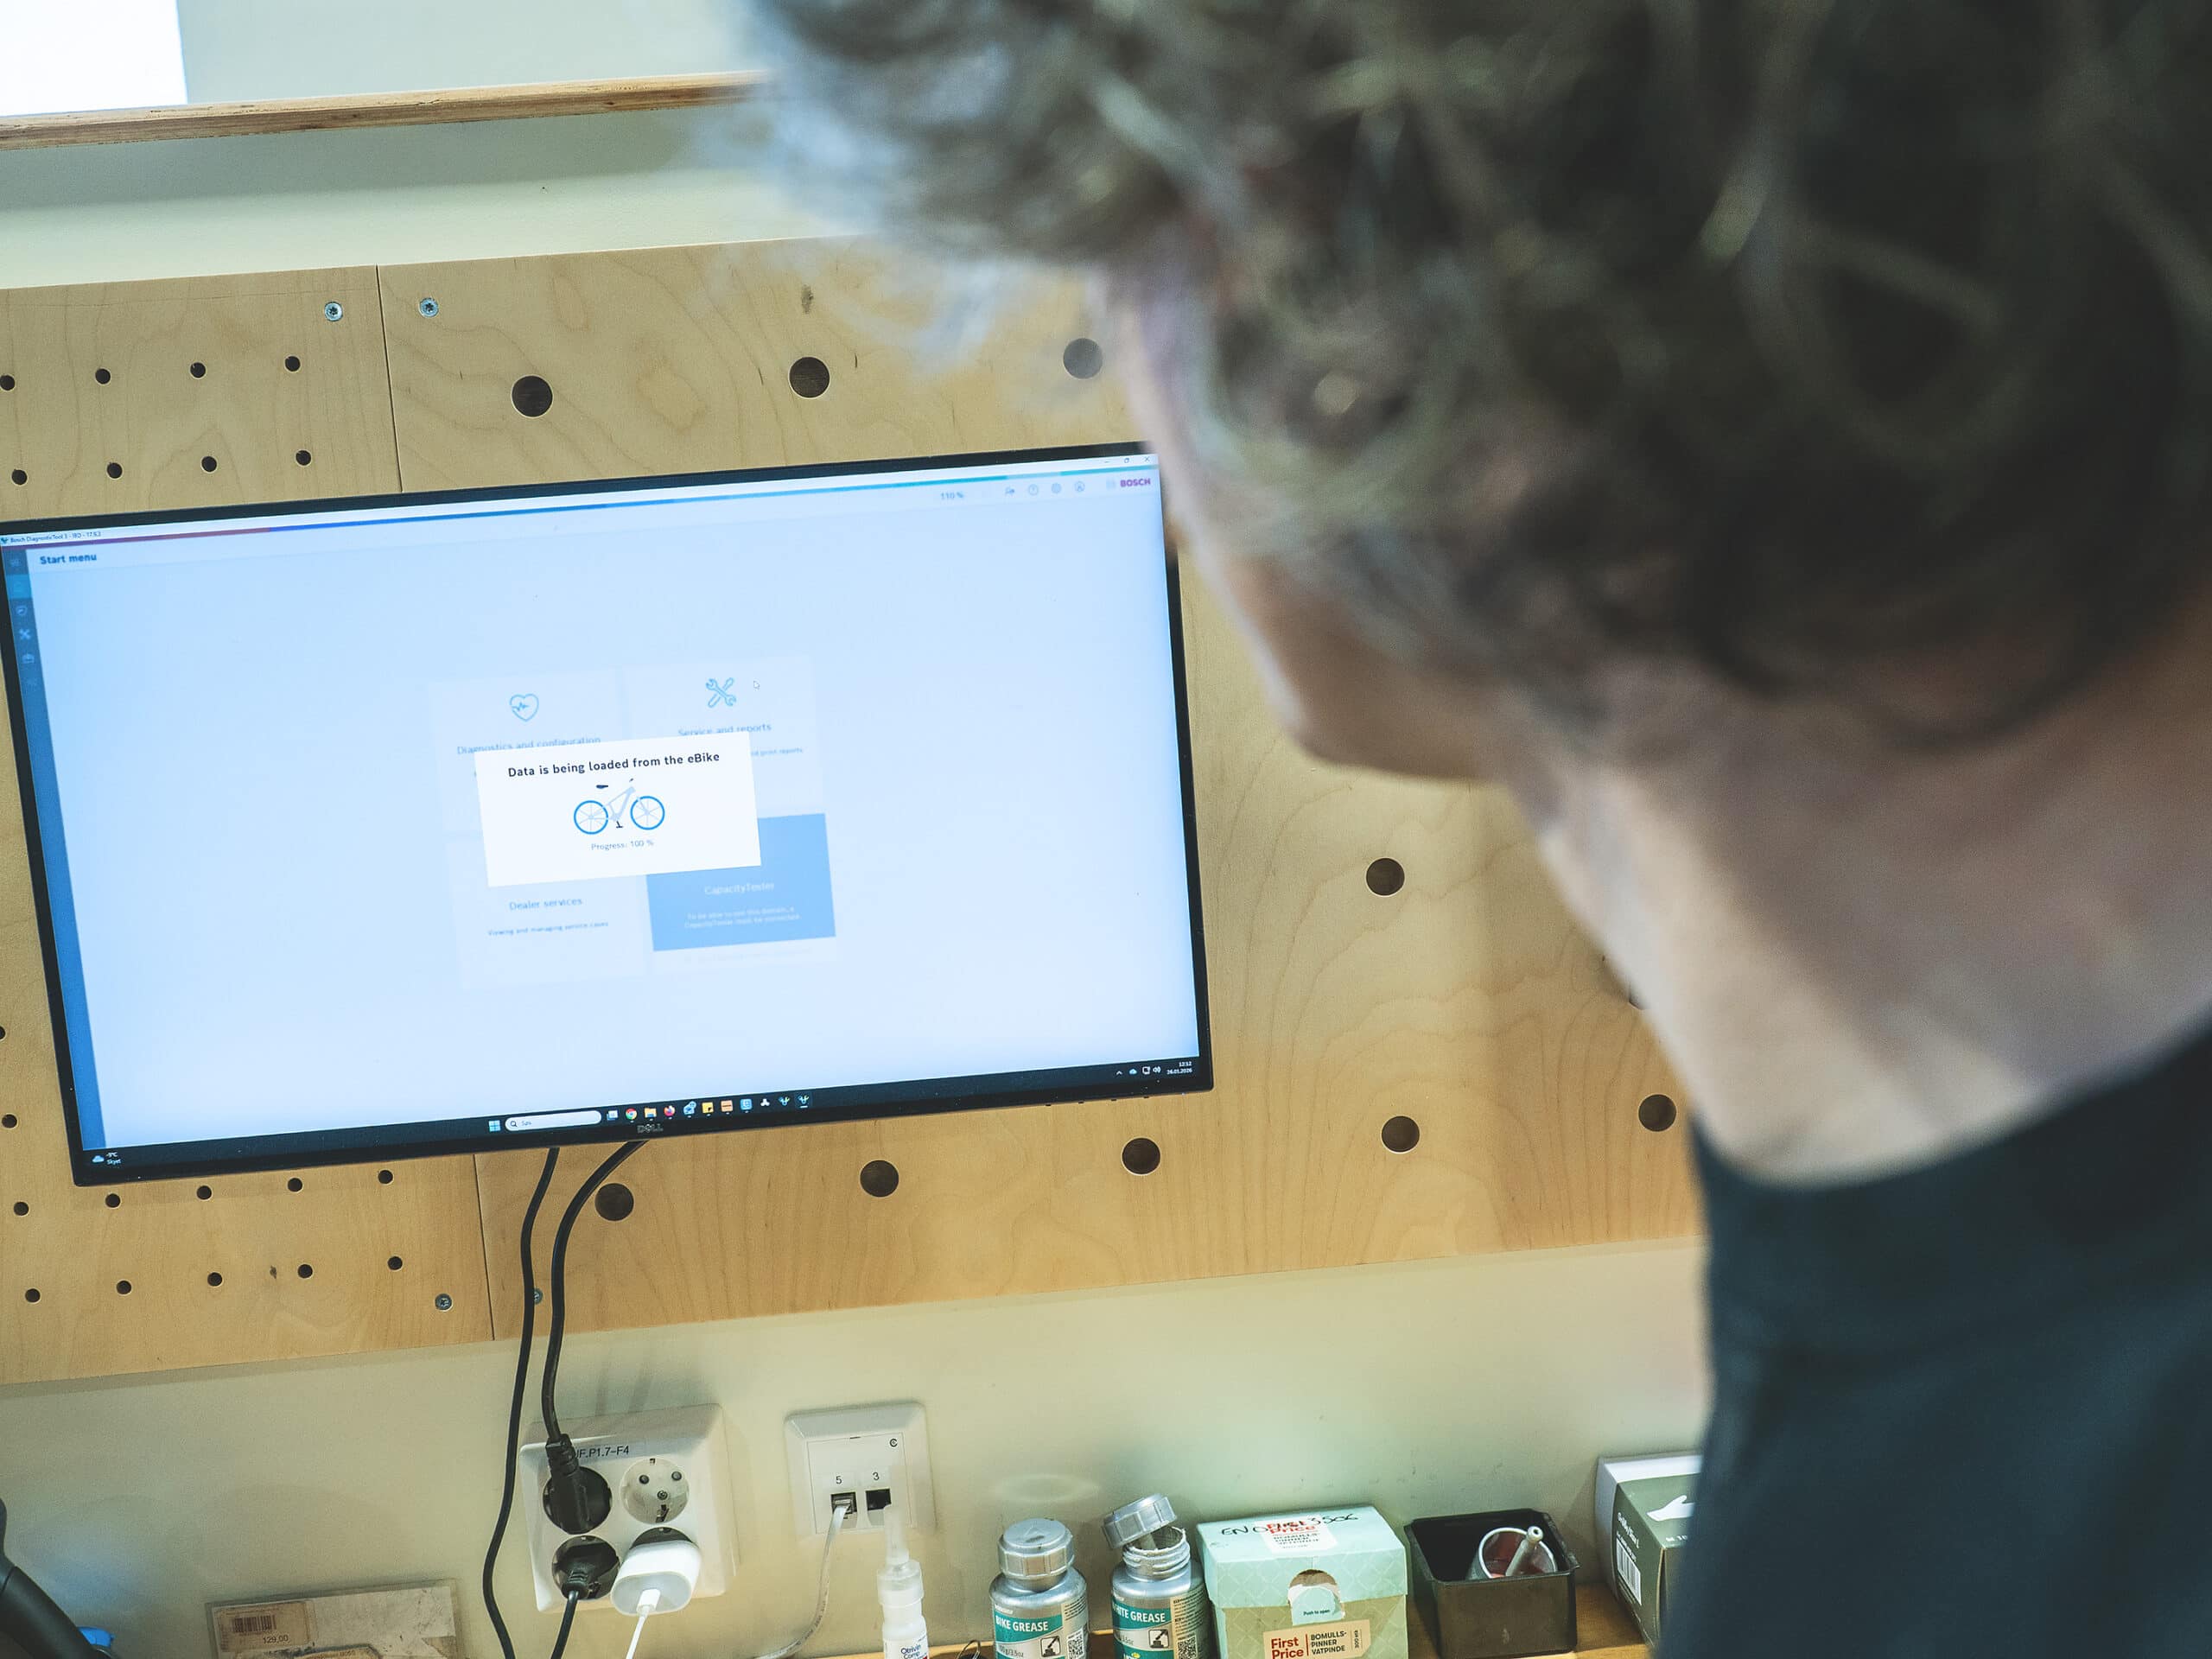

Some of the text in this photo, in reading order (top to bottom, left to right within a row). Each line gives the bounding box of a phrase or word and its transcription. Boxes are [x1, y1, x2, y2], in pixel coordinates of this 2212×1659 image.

[1120, 478, 1151, 488] BOSCH
[940, 491, 955, 500] 110
[40, 554, 97, 564] Start menu
[678, 728, 713, 736] Service
[737, 723, 772, 733] reports
[457, 736, 601, 754] Diagnostics and configuration
[508, 752, 720, 778] Data is being loaded from the eBike
[591, 842, 628, 852] Progress:
[509, 898, 583, 911] Dealer services
[637, 1124, 664, 1134] DELL
[836, 1471, 880, 1484] 5 3
[995, 1614, 1049, 1632] BIKE GREASE
[1130, 1611, 1166, 1623] GREASE
[1311, 1630, 1347, 1641] BOMULLS-
[901, 1643, 921, 1655] Otrivin
[1271, 1637, 1299, 1649] First
[1272, 1648, 1305, 1659] Price
[1312, 1645, 1345, 1656] VATPINDE
